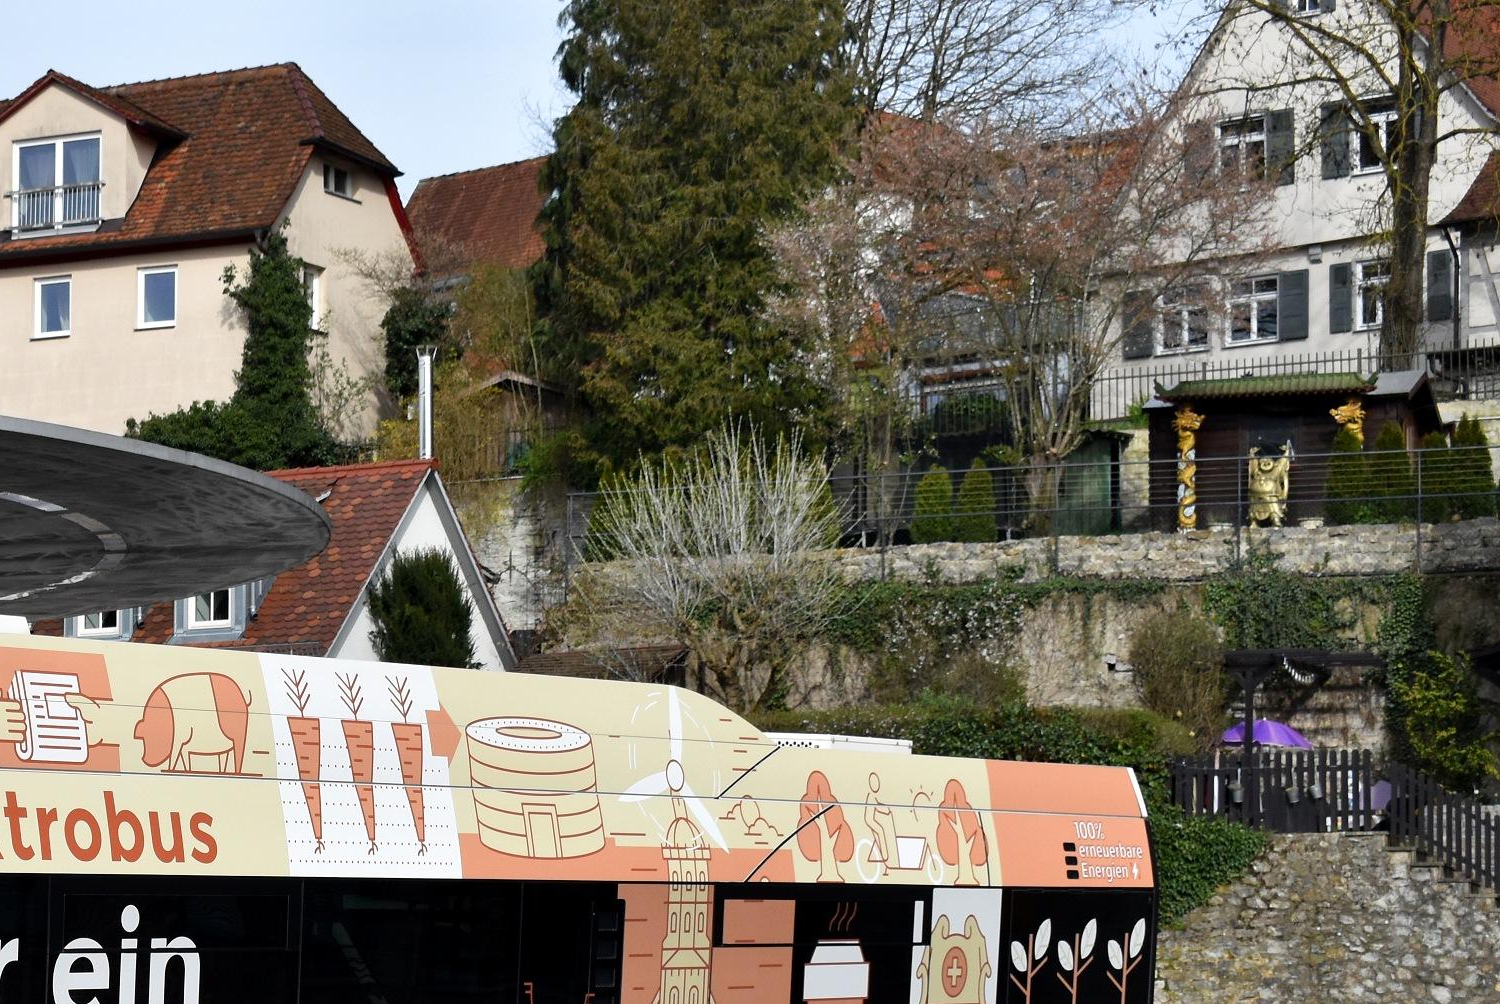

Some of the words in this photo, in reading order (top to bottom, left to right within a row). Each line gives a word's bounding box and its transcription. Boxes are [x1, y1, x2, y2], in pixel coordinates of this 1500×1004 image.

[1073, 821, 1105, 840] 100%
[1078, 842, 1143, 859] erneuerbare
[1081, 862, 1129, 883] Energien
